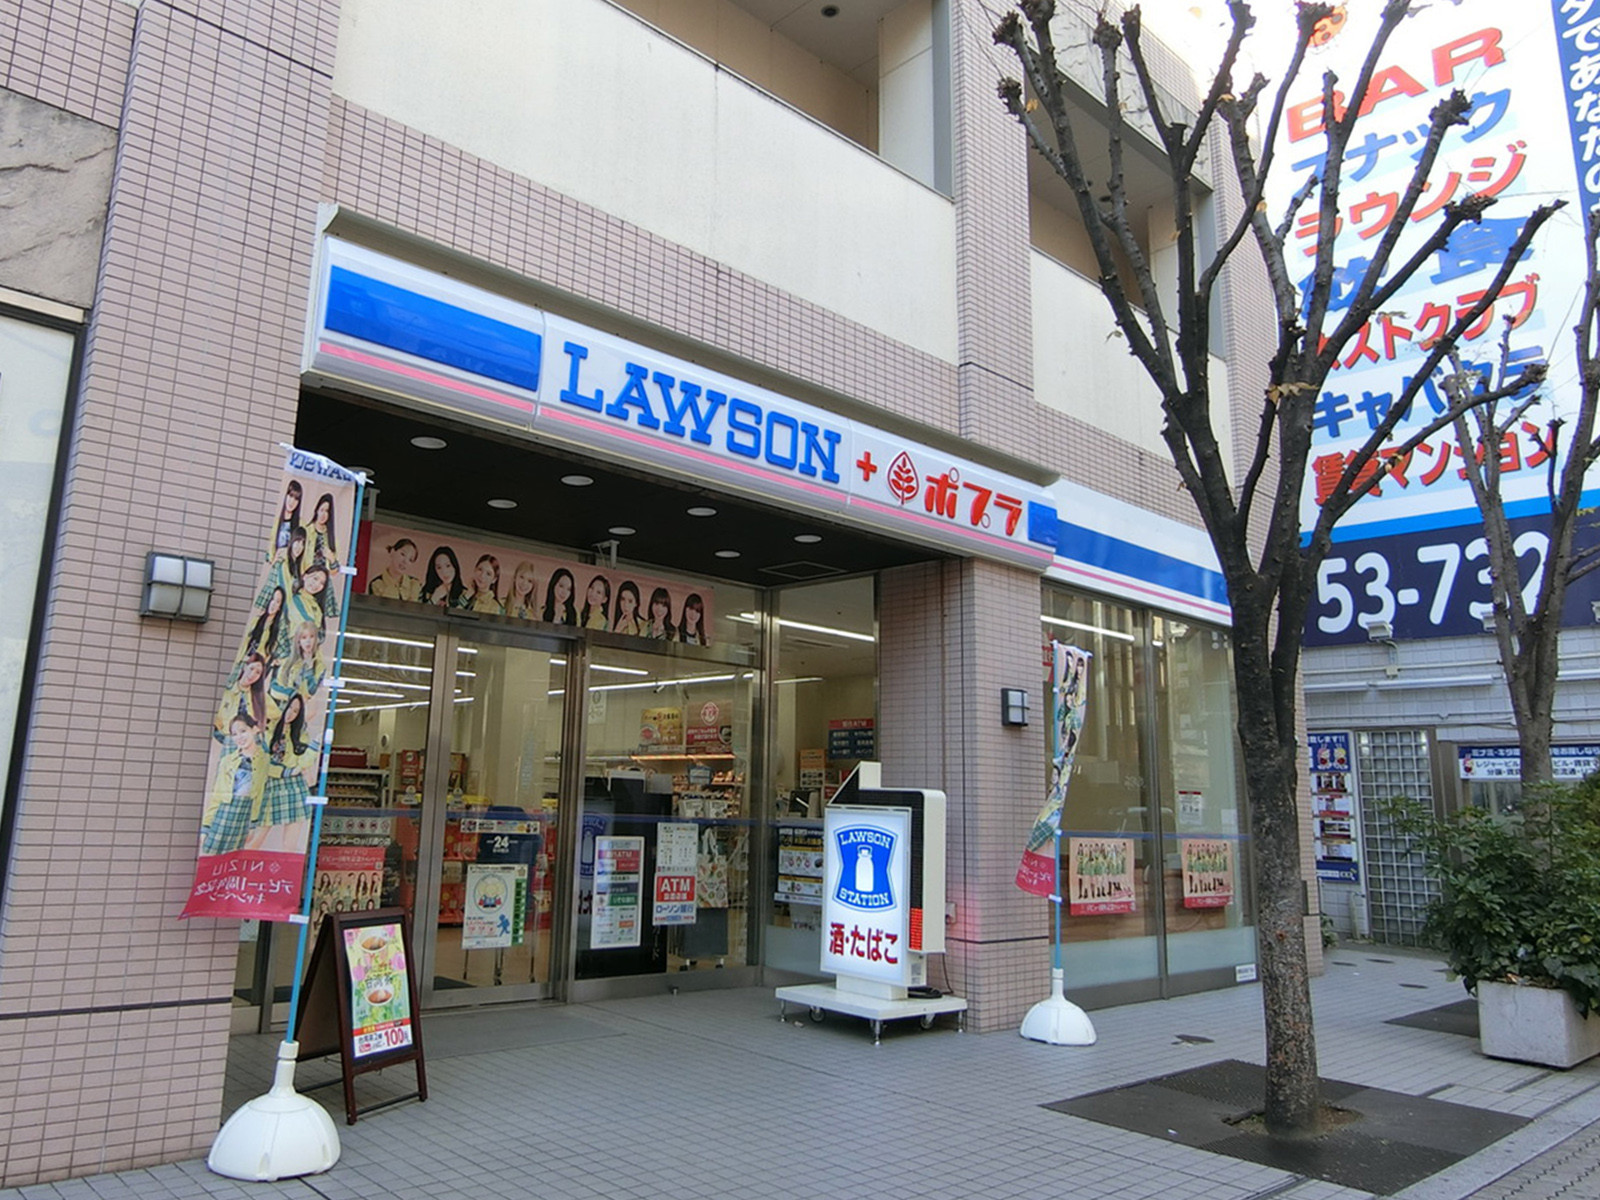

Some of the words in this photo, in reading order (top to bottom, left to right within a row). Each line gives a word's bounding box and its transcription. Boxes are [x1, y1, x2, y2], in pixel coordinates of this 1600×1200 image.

[1286, 26, 1506, 144] BAR
[560, 340, 842, 484] LAWSON
[923, 466, 1023, 537] ポプラ
[318, 836, 391, 848] ーソンヨーロッパ通り店
[840, 831, 891, 849] LAWSON
[660, 877, 691, 893] ATM
[839, 887, 890, 907] STATION
[829, 921, 899, 965] 酒・たばこ
